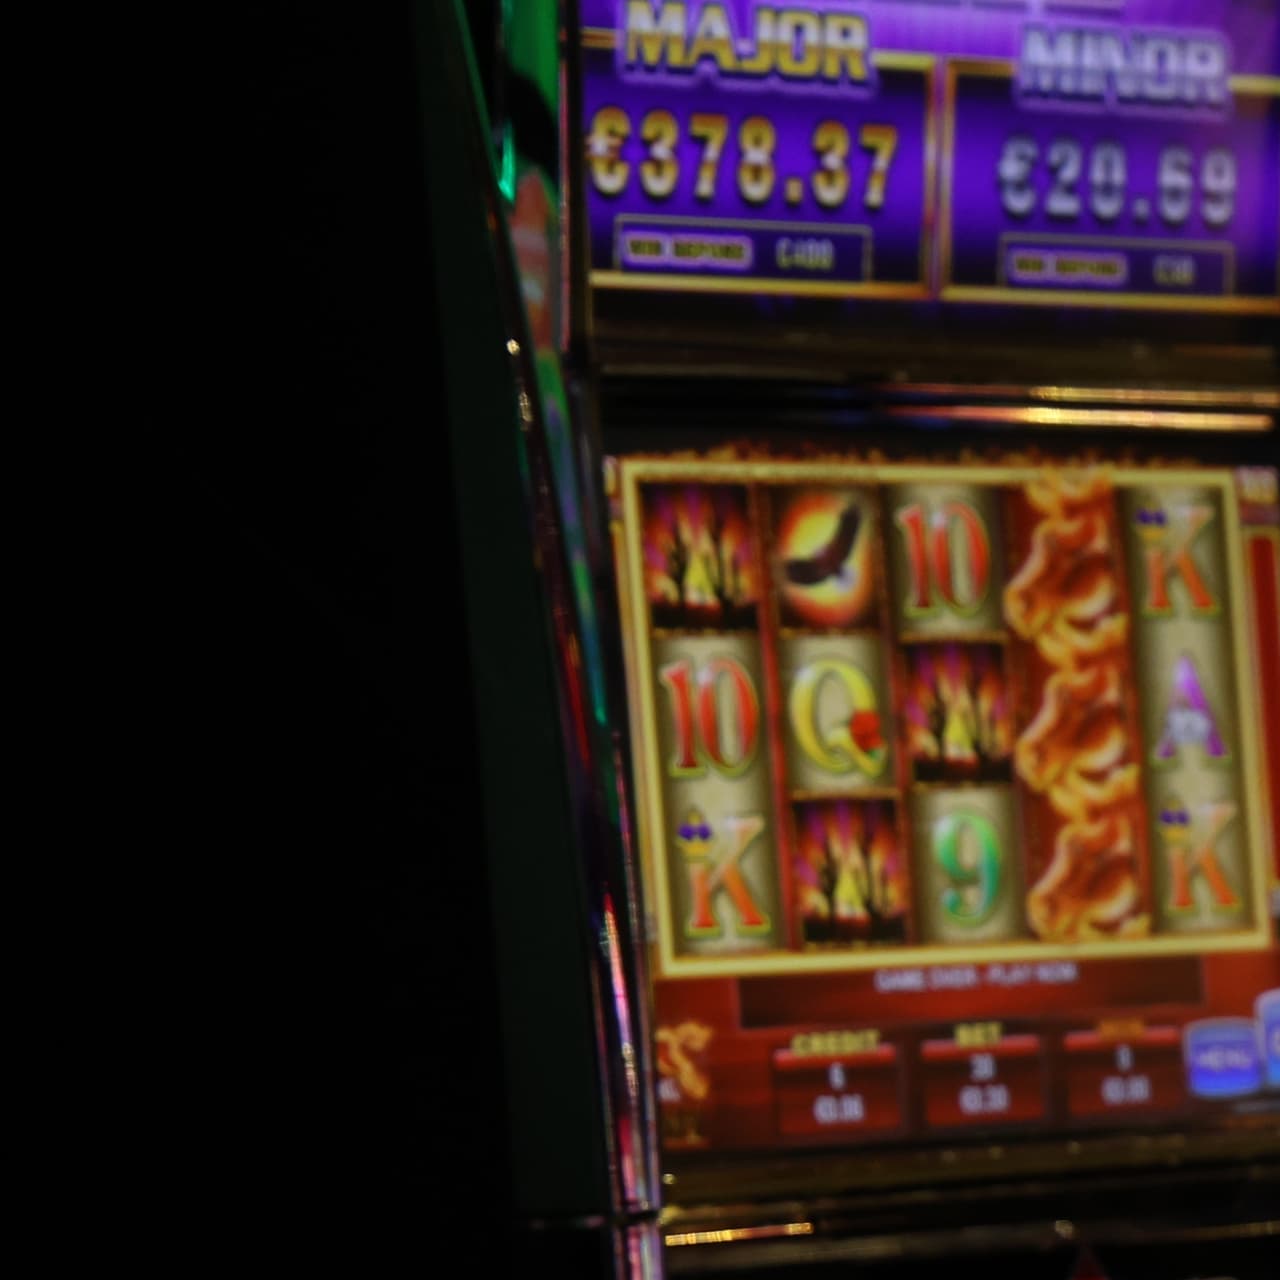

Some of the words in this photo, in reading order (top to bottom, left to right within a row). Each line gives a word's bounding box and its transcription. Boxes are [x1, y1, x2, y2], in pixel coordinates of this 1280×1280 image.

[625, 0, 869, 82] MAJOR
[1020, 27, 1226, 101] MINOR
[587, 107, 898, 207] €378.37
